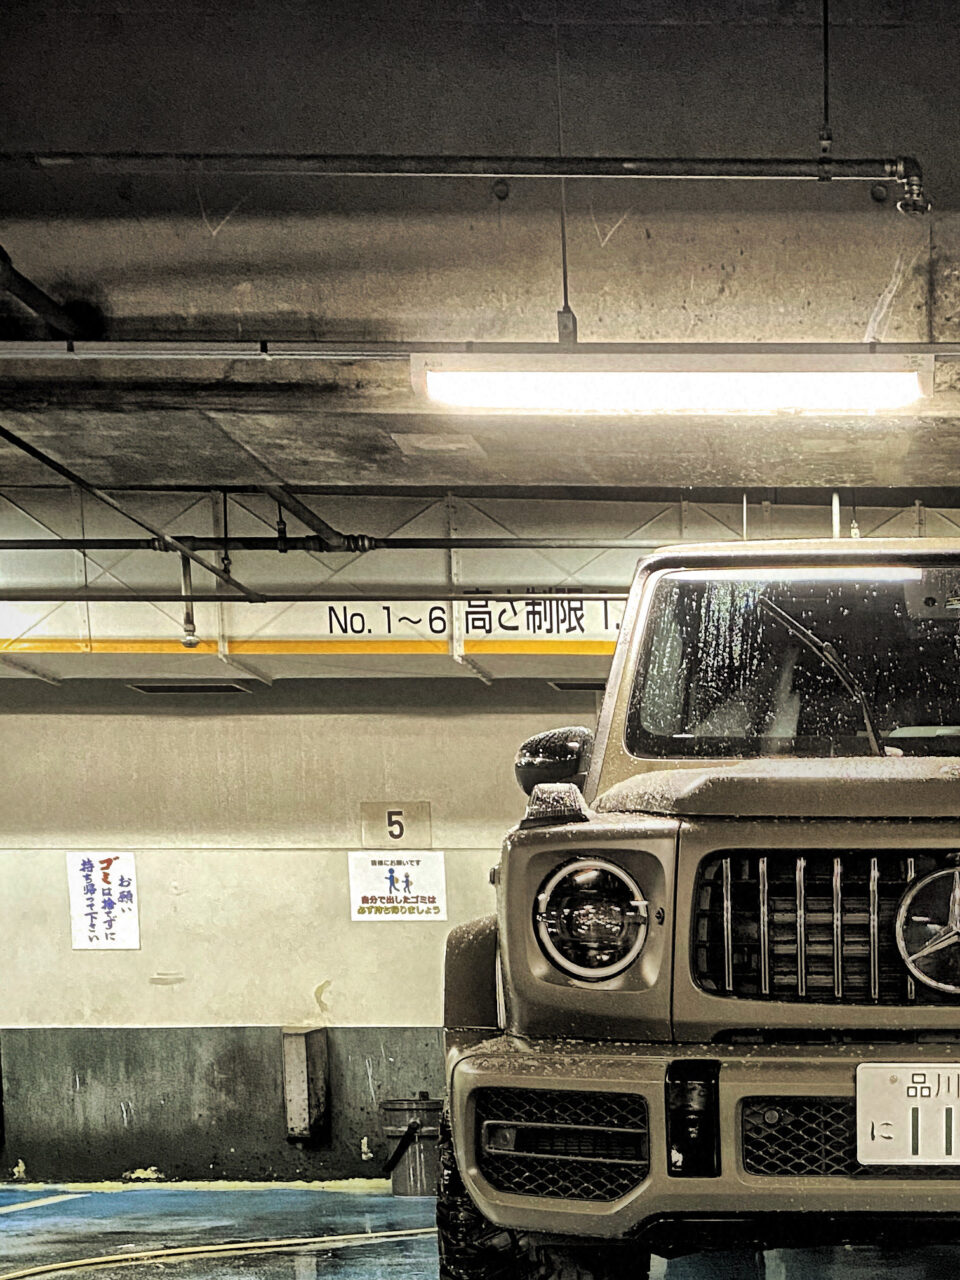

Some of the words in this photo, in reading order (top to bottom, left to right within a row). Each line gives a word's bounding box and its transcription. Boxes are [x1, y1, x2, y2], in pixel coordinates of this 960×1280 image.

[463, 587, 585, 634] 高さ制限
[387, 810, 405, 839] 5
[79, 857, 100, 943] 持ち帰って下さい
[99, 856, 120, 940] ゴミは捨てずに
[117, 874, 134, 913] お願い
[361, 895, 437, 905] 自分で出したゴミは
[870, 1121, 894, 1141] に
